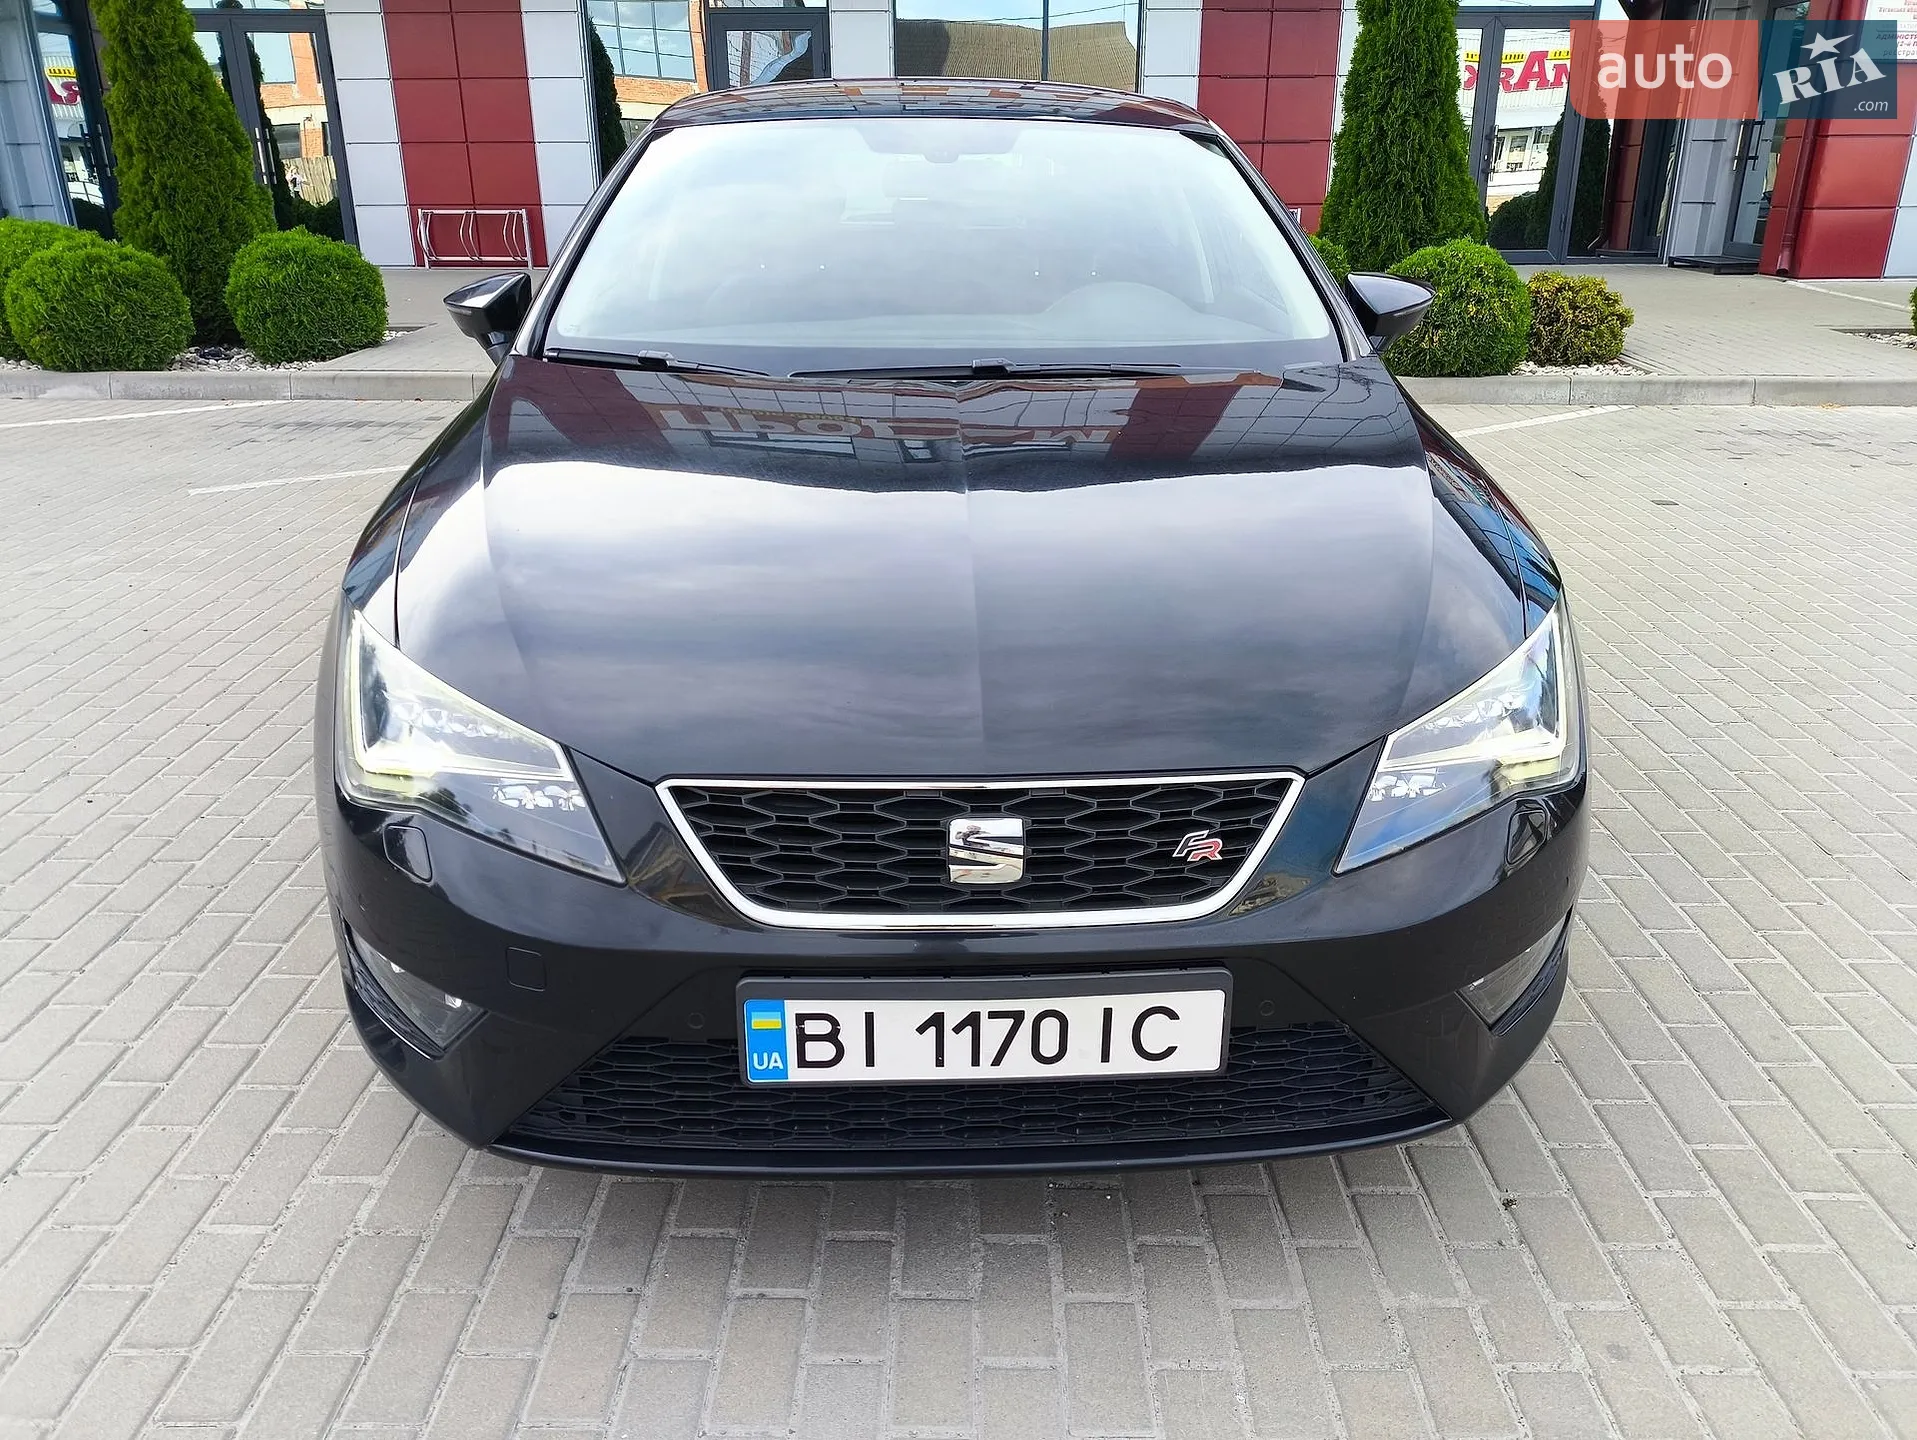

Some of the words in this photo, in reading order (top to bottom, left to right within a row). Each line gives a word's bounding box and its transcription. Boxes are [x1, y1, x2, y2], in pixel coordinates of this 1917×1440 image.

[1172, 830, 1223, 861] FR
[795, 1011, 875, 1069] BI
[915, 1008, 1069, 1067] 1170
[1100, 1005, 1181, 1063] IC
[753, 1053, 784, 1070] UA
